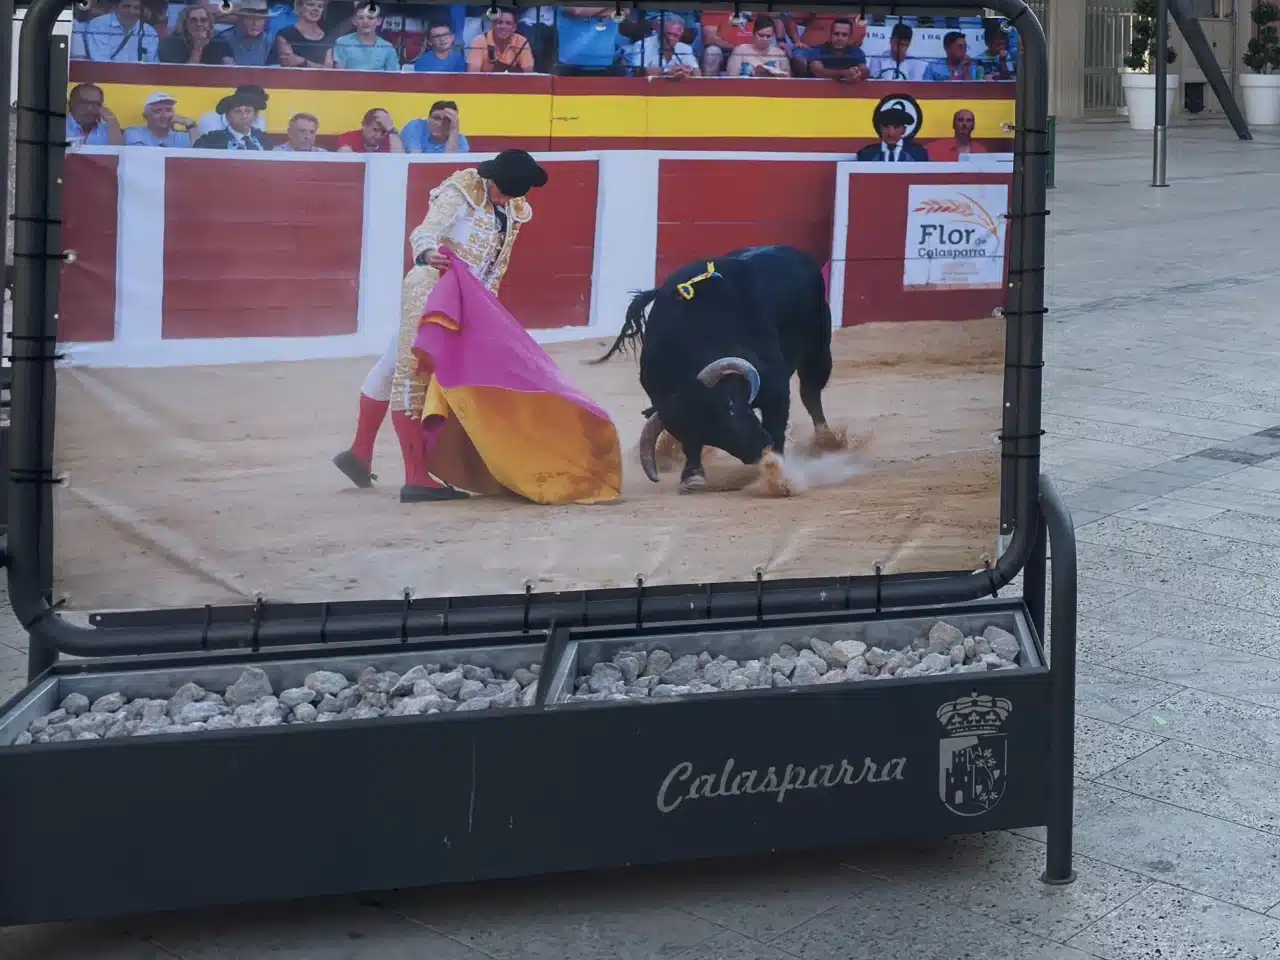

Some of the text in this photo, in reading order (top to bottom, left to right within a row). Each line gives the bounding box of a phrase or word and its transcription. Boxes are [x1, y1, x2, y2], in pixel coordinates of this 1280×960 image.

[918, 224, 975, 245] Flor
[918, 247, 986, 260] Calasparra
[656, 756, 908, 813] Calasparra
